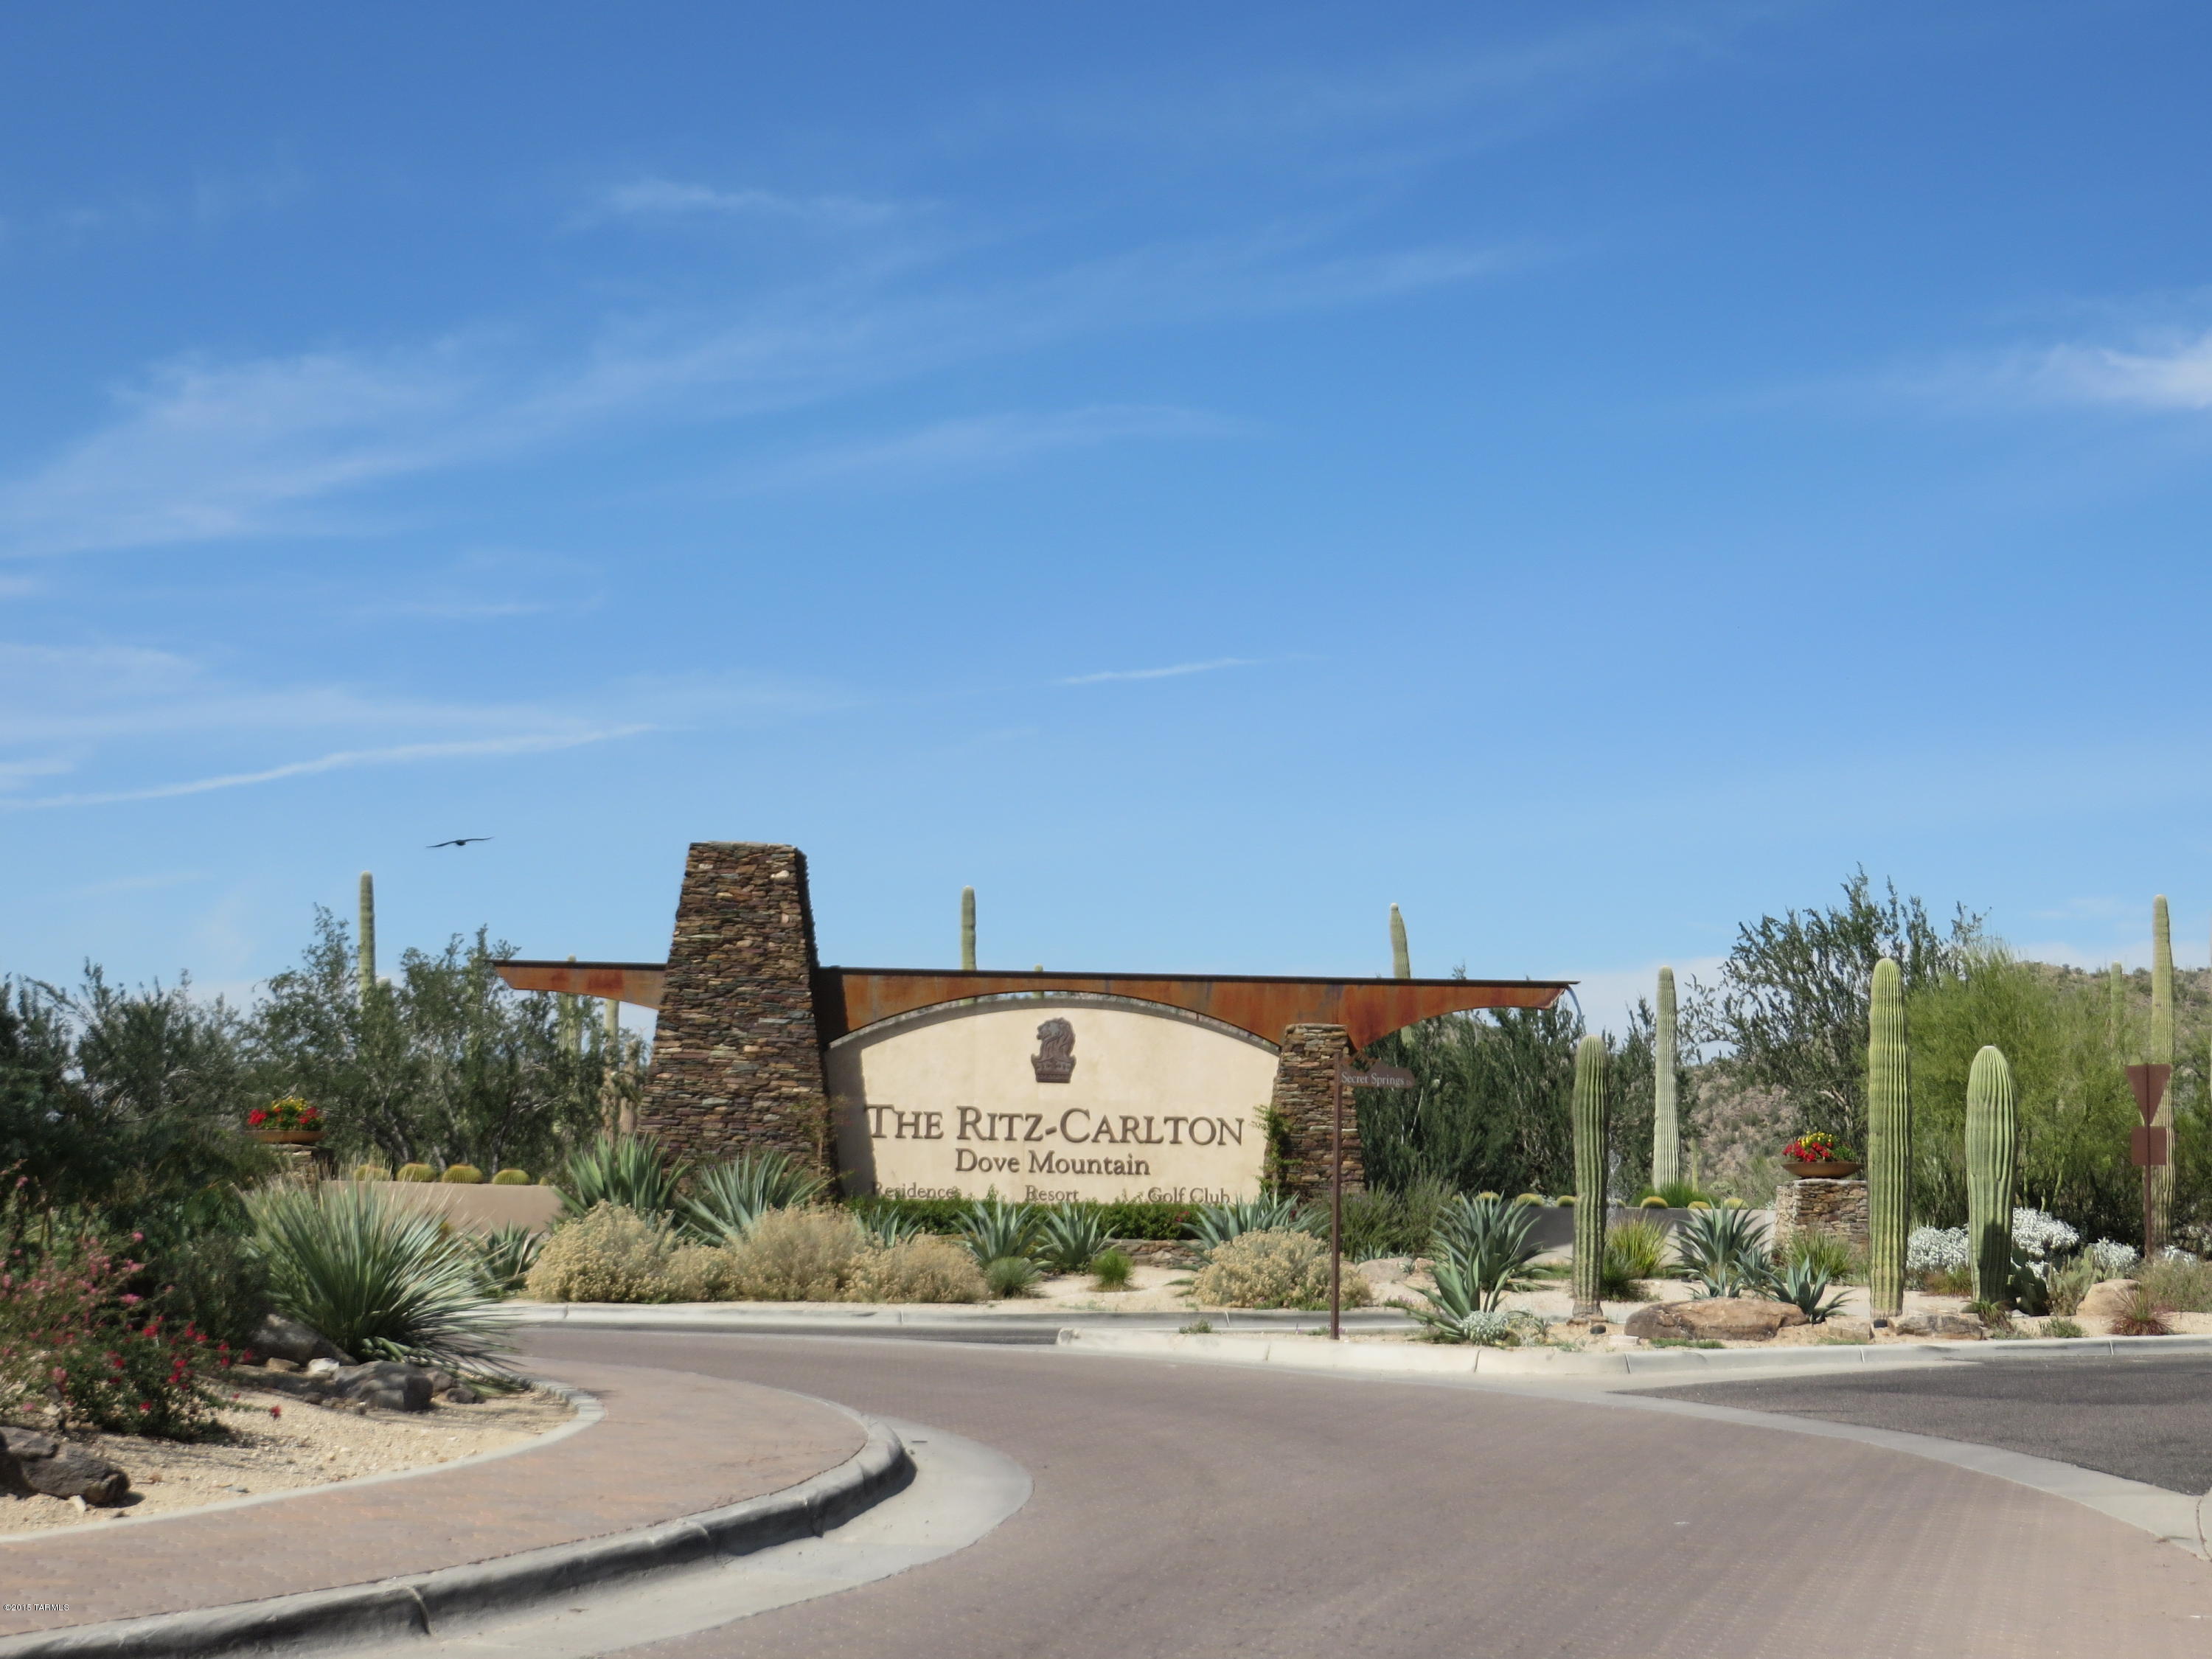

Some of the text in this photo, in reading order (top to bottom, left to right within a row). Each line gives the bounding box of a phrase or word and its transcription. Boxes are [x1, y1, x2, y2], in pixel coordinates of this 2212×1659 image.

[1341, 1071, 1368, 1084] Secret
[1371, 1073, 1405, 1088] Springs
[866, 1104, 1245, 1146] THE RITZ-CARLTON
[955, 1148, 1150, 1175] Dove Mountain
[873, 1181, 1231, 1204] Residence Resort Golf Club
